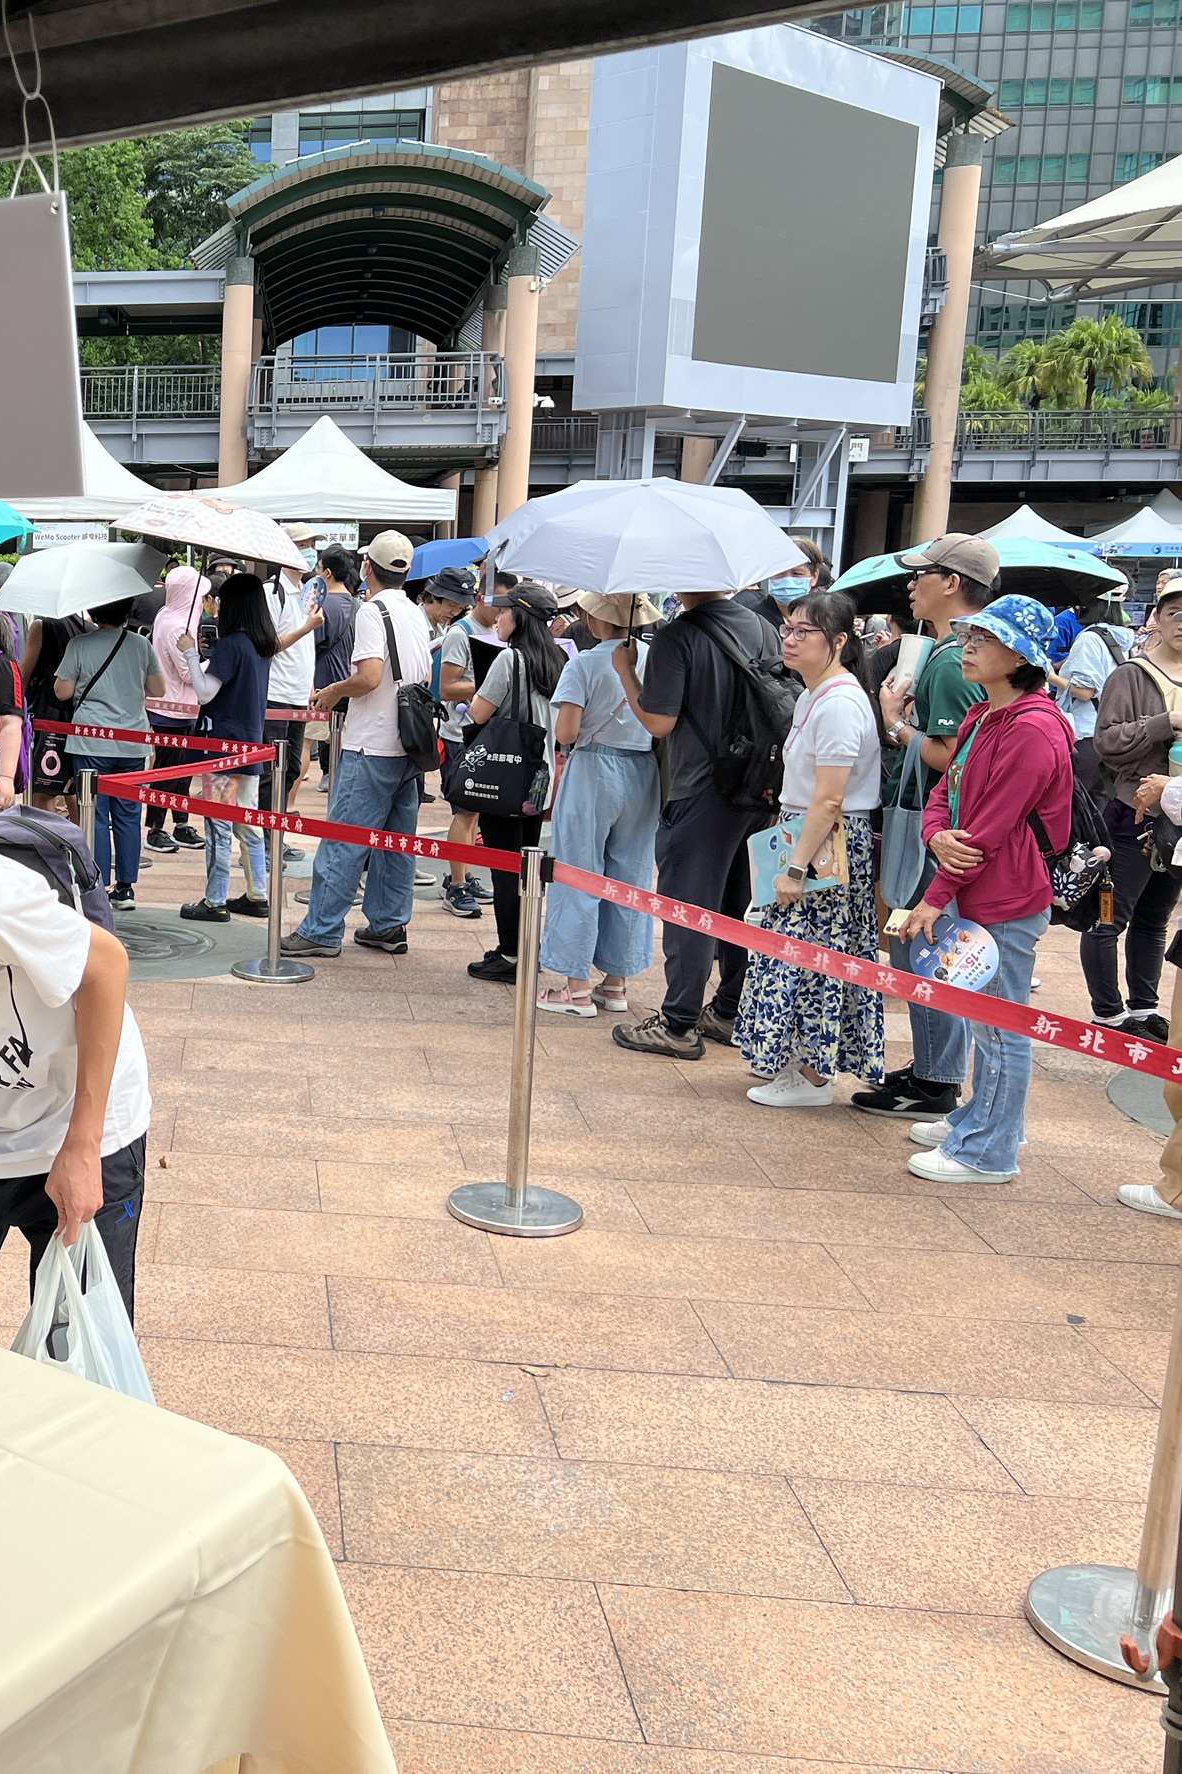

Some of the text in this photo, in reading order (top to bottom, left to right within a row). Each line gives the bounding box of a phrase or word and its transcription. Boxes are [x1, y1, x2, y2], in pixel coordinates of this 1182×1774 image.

[75, 725, 114, 739] 新北市政府
[145, 734, 188, 748] 新北市政府
[138, 789, 189, 810] 新北市政府
[244, 810, 303, 832] 新北市政府
[369, 831, 440, 856] 新北市政府
[602, 881, 714, 931] 新北市政府
[779, 941, 935, 1003] 新北市政府
